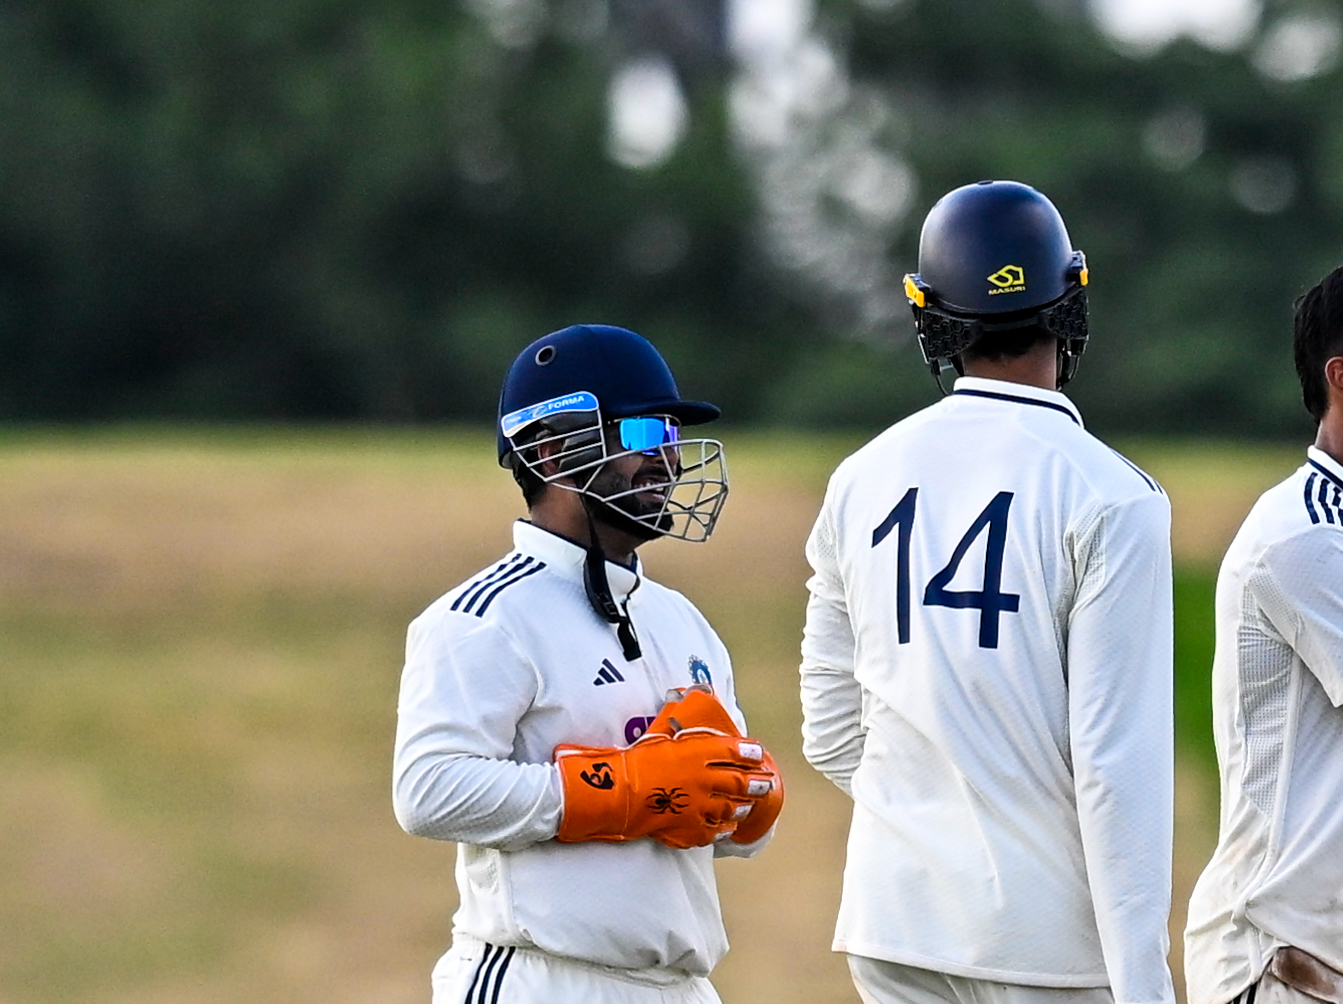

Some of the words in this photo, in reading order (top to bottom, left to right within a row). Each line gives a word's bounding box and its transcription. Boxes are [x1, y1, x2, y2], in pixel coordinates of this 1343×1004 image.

[988, 286, 1026, 296] MASURI
[548, 395, 584, 410] FORMA
[871, 487, 1020, 649] 14
